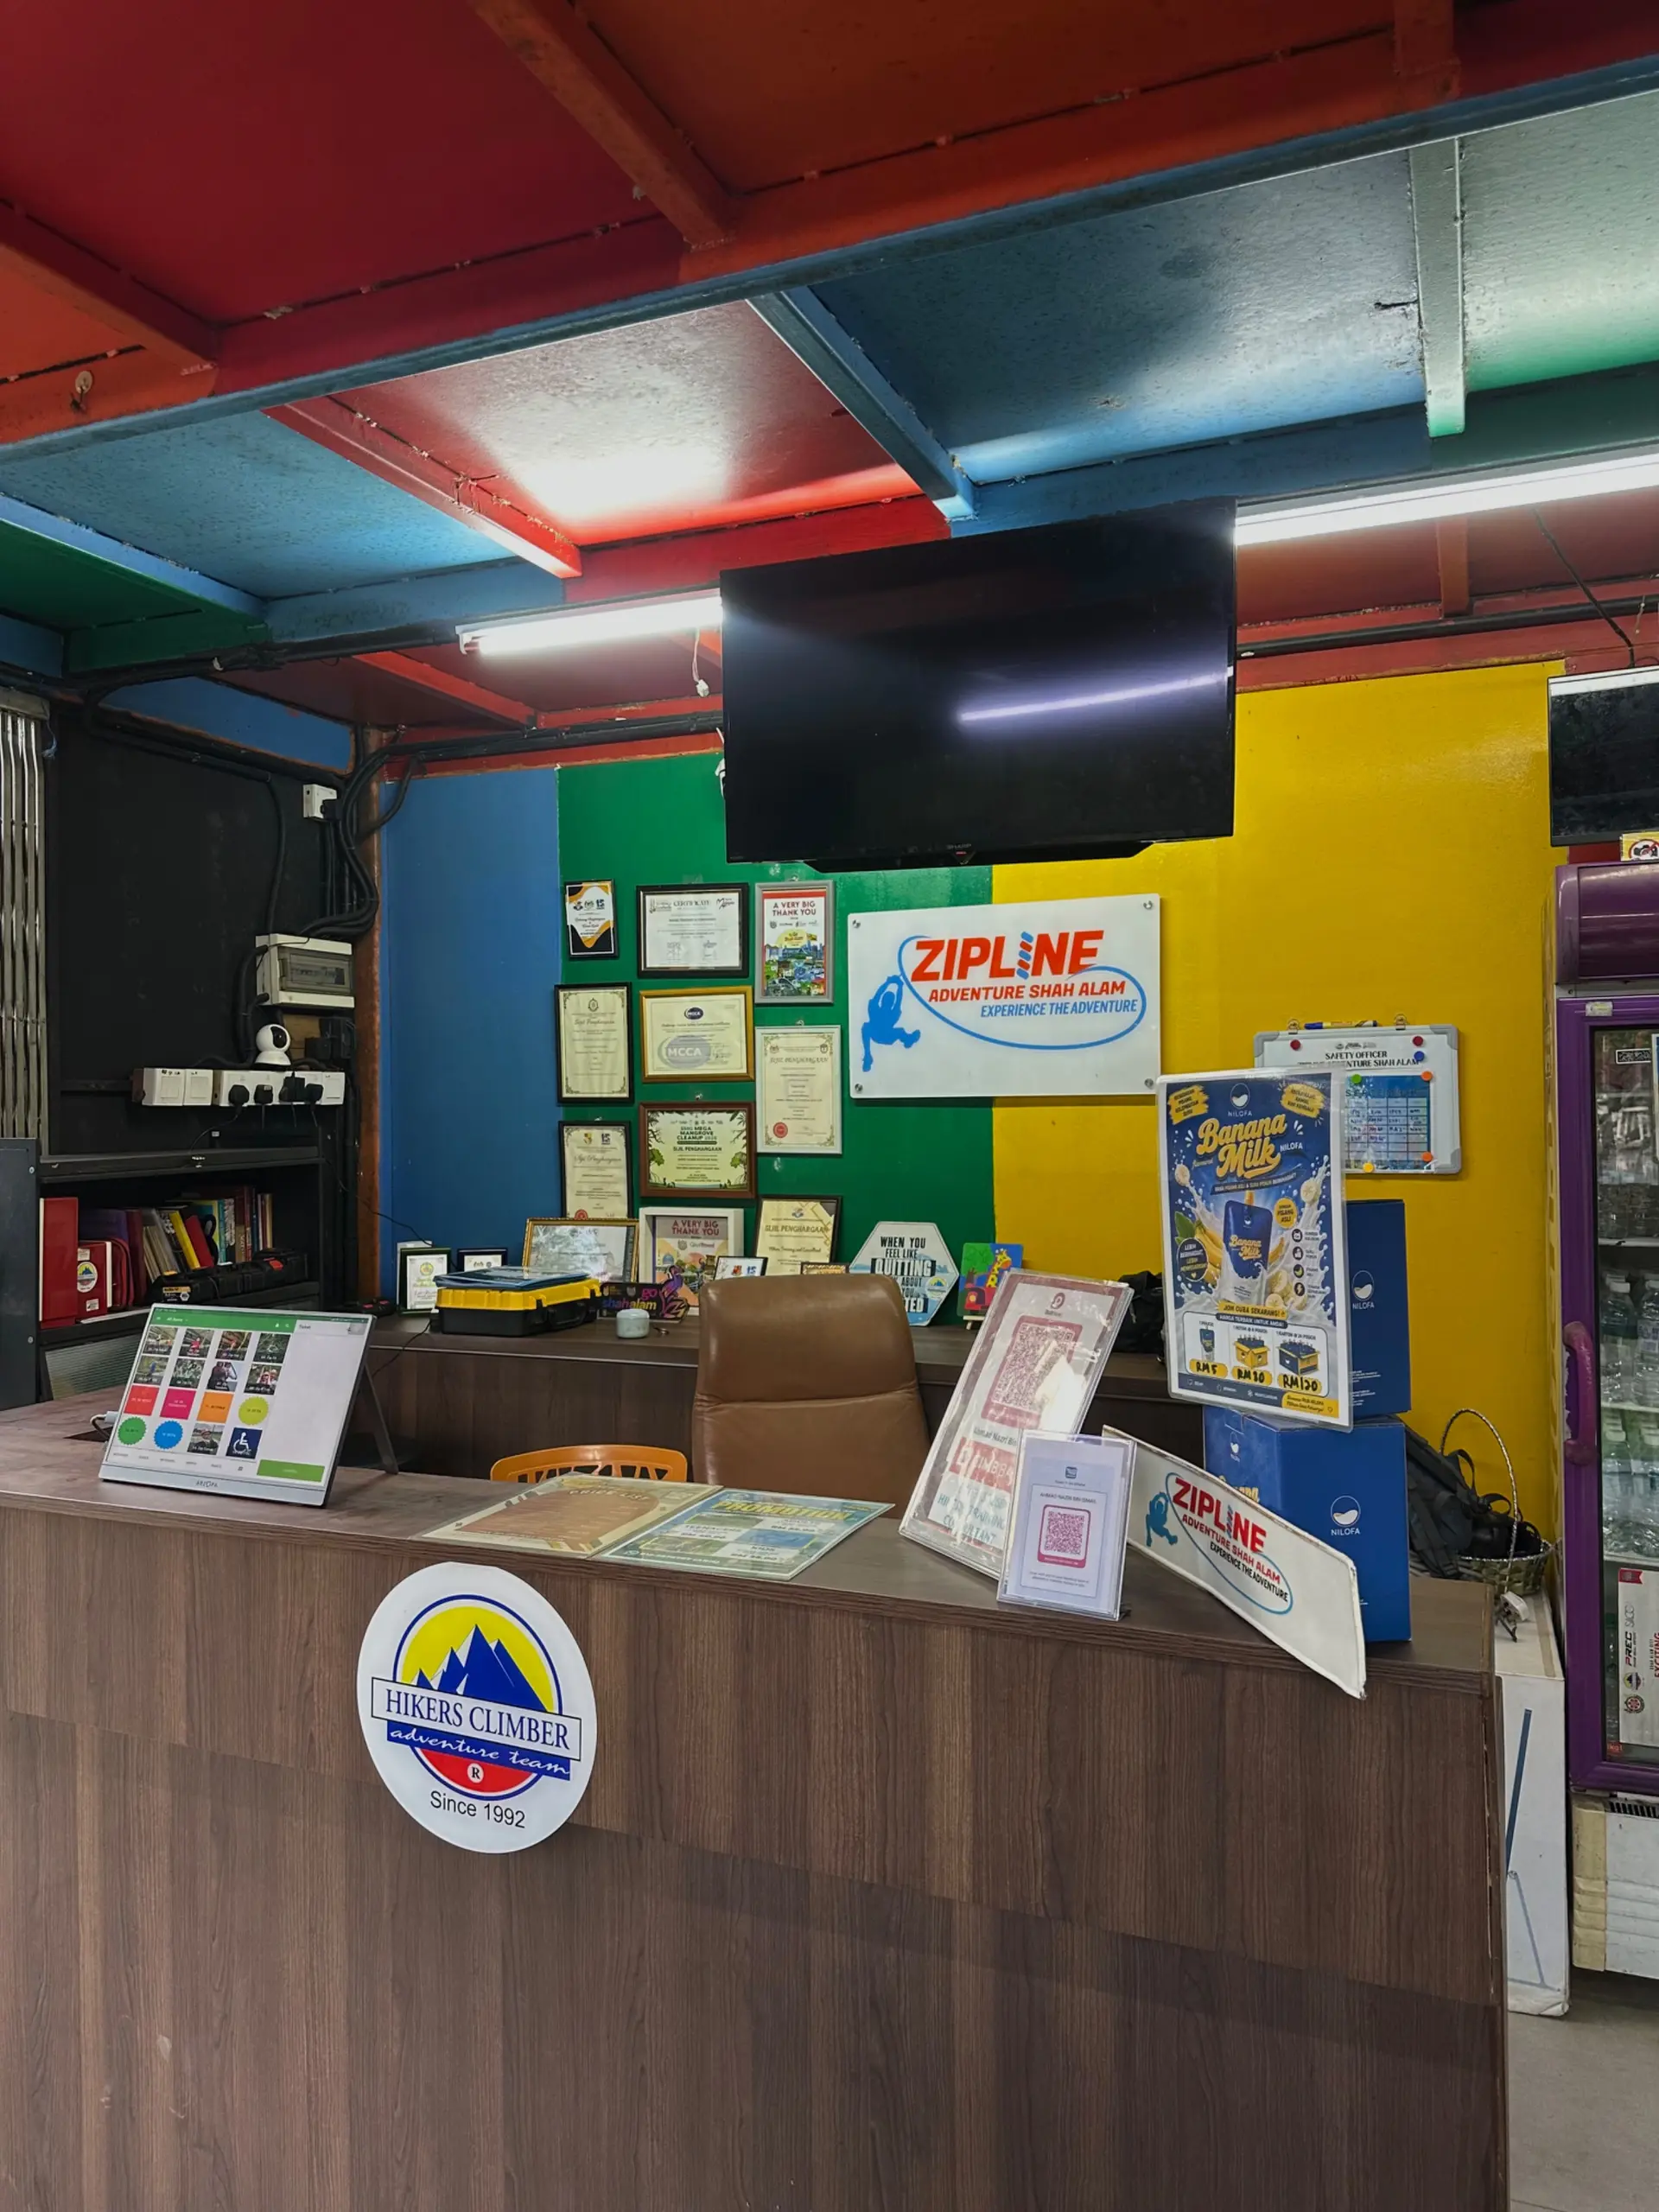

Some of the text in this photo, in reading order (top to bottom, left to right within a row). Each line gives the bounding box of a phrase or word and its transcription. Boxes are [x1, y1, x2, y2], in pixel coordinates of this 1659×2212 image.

[911, 930, 1103, 981] ZIPLINE
[929, 981, 1126, 1002] ADVENTURE SHAH ALAM
[981, 999, 1138, 1017] EXPERIENCE THE ADVENTURE
[668, 1047, 702, 1057] MCCA
[1196, 1114, 1287, 1155] Banana
[1280, 1143, 1303, 1152] NILOFA
[1217, 1137, 1281, 1179] Milk
[671, 1227, 720, 1236] THANK YOU
[704, 1219, 718, 1228] BIG
[880, 1236, 925, 1248] WHEN YOU
[1230, 1235, 1262, 1248] Banana
[886, 1249, 917, 1258] FEEL LIKE
[875, 1259, 932, 1277] QUITTING
[901, 1276, 922, 1287] ABOUT
[641, 1288, 657, 1300] go
[902, 1287, 913, 1297] YOU
[711, 1500, 854, 1521] PROMOTION
[1173, 1477, 1268, 1554] ZIPLINE
[1332, 1528, 1361, 1536] NILOFA
[1182, 1513, 1281, 1584] ADVENTURE SHAH ALAM
[1210, 1541, 1288, 1602] EXPERIENCE THE ADVENTURE
[1624, 1631, 1633, 1667] PREC
[386, 1688, 569, 1750] HIKERS CLIMBER
[390, 1728, 570, 1775] adventure team
[430, 1790, 525, 1828] Since 1992
